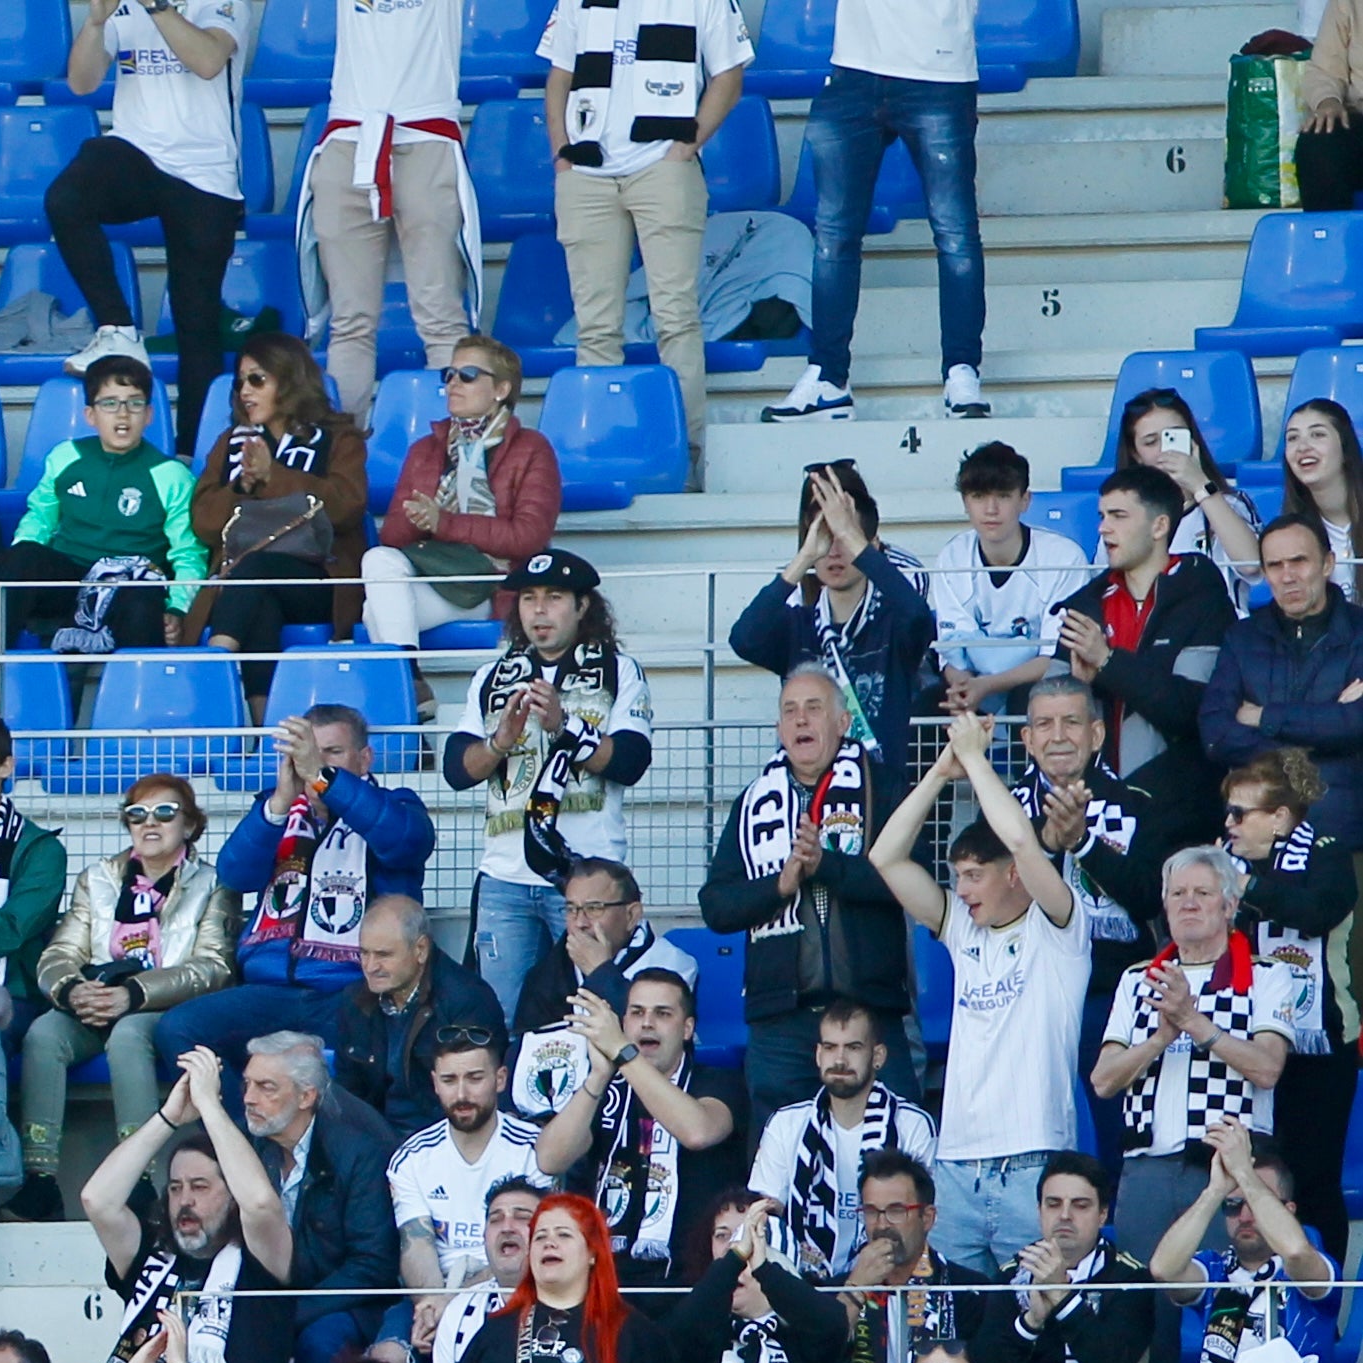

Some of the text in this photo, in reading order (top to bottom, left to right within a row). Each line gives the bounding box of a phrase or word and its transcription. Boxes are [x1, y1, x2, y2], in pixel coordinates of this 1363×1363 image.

[1166, 145, 1186, 175] 6
[1040, 287, 1062, 318] 5
[898, 425, 922, 454] 4
[83, 1293, 103, 1321] 6
